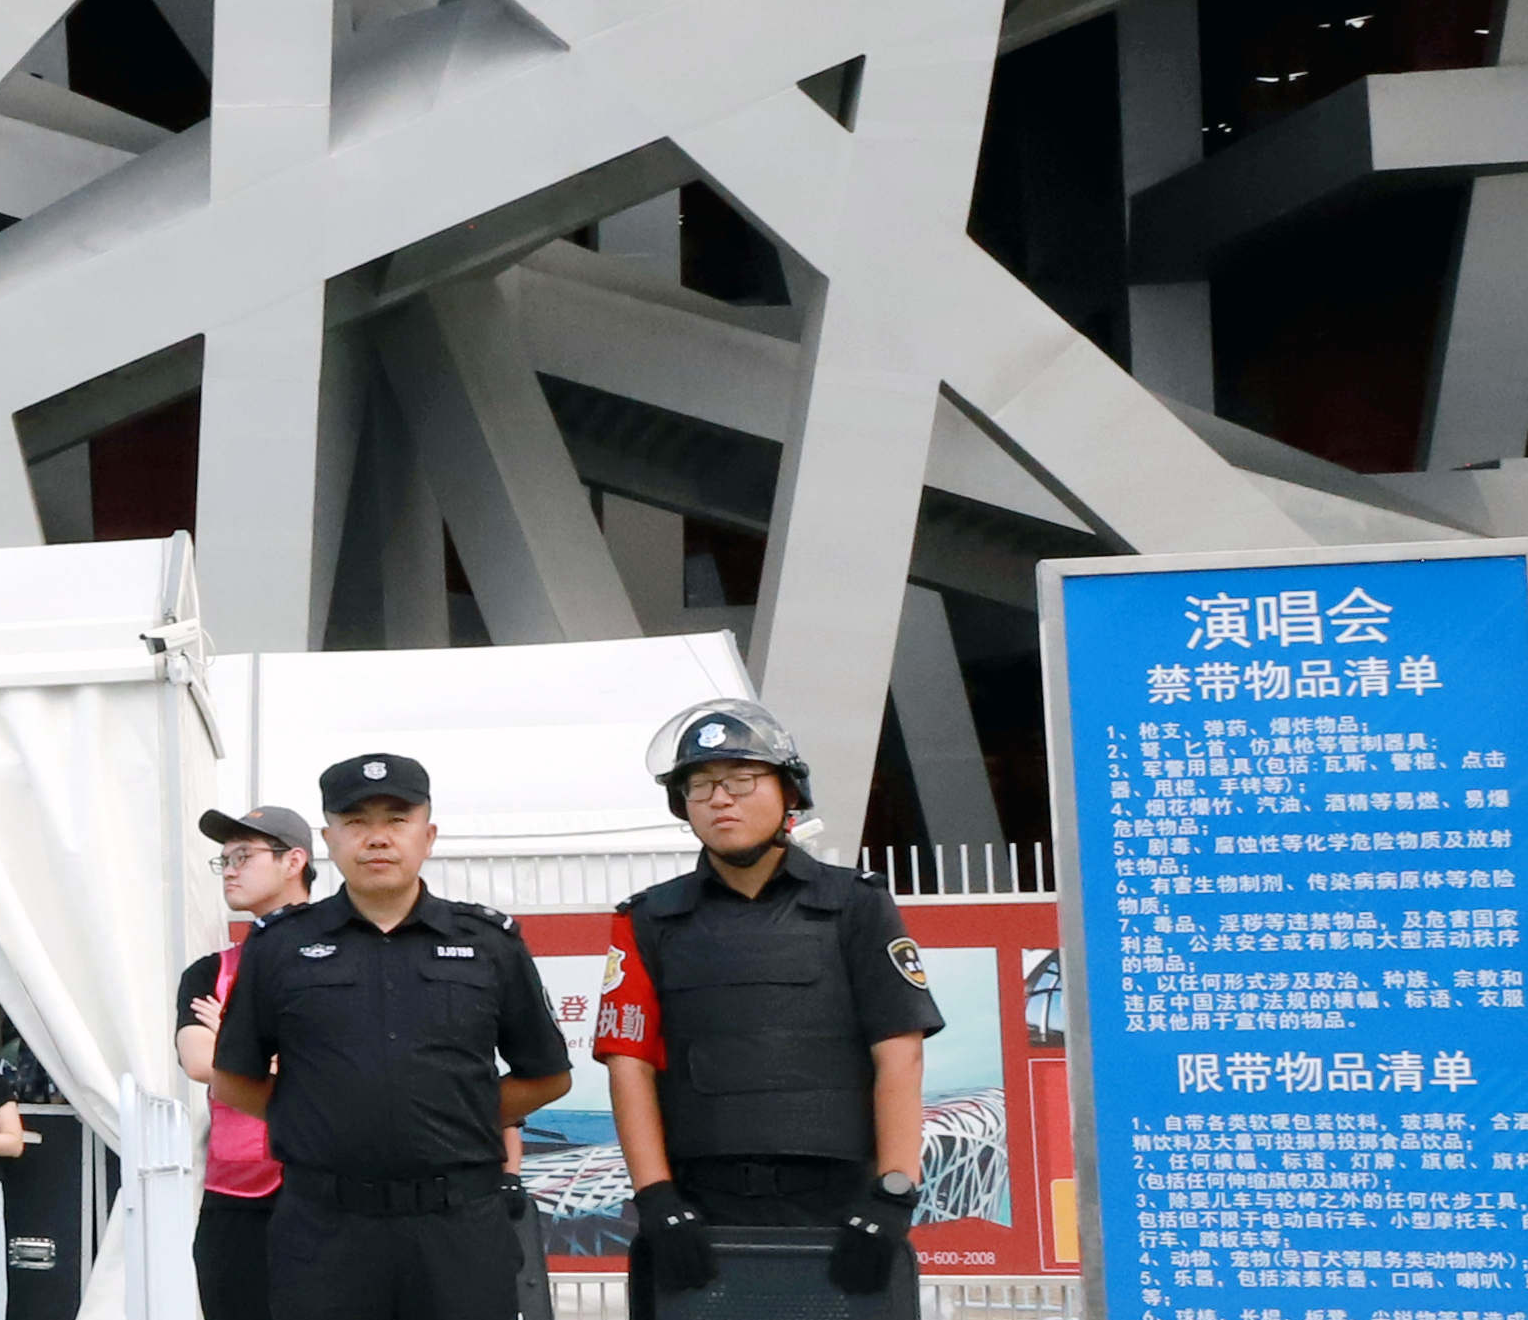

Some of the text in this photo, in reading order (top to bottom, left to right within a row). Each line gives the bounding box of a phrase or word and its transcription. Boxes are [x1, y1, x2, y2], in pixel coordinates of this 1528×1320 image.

[1183, 586, 1394, 651] 演唱会
[1146, 654, 1444, 705] 禁带物品清单
[1113, 817, 1209, 838] 危险物品；
[1115, 857, 1190, 877] 性物品；
[1117, 896, 1170, 915] 物质；
[1121, 955, 1195, 974] 的物品；
[1124, 989, 1525, 1013] 违反中国法律法规的横幅、标语、衣服
[598, 1001, 645, 1042] 执勤
[1126, 1012, 1357, 1032] 及其他用于宣传的物品。
[1178, 1050, 1478, 1094] 限带物品清单
[1140, 1270, 1528, 1290] 5、乐器，包括演奏乐器、口哨、喇叭、
